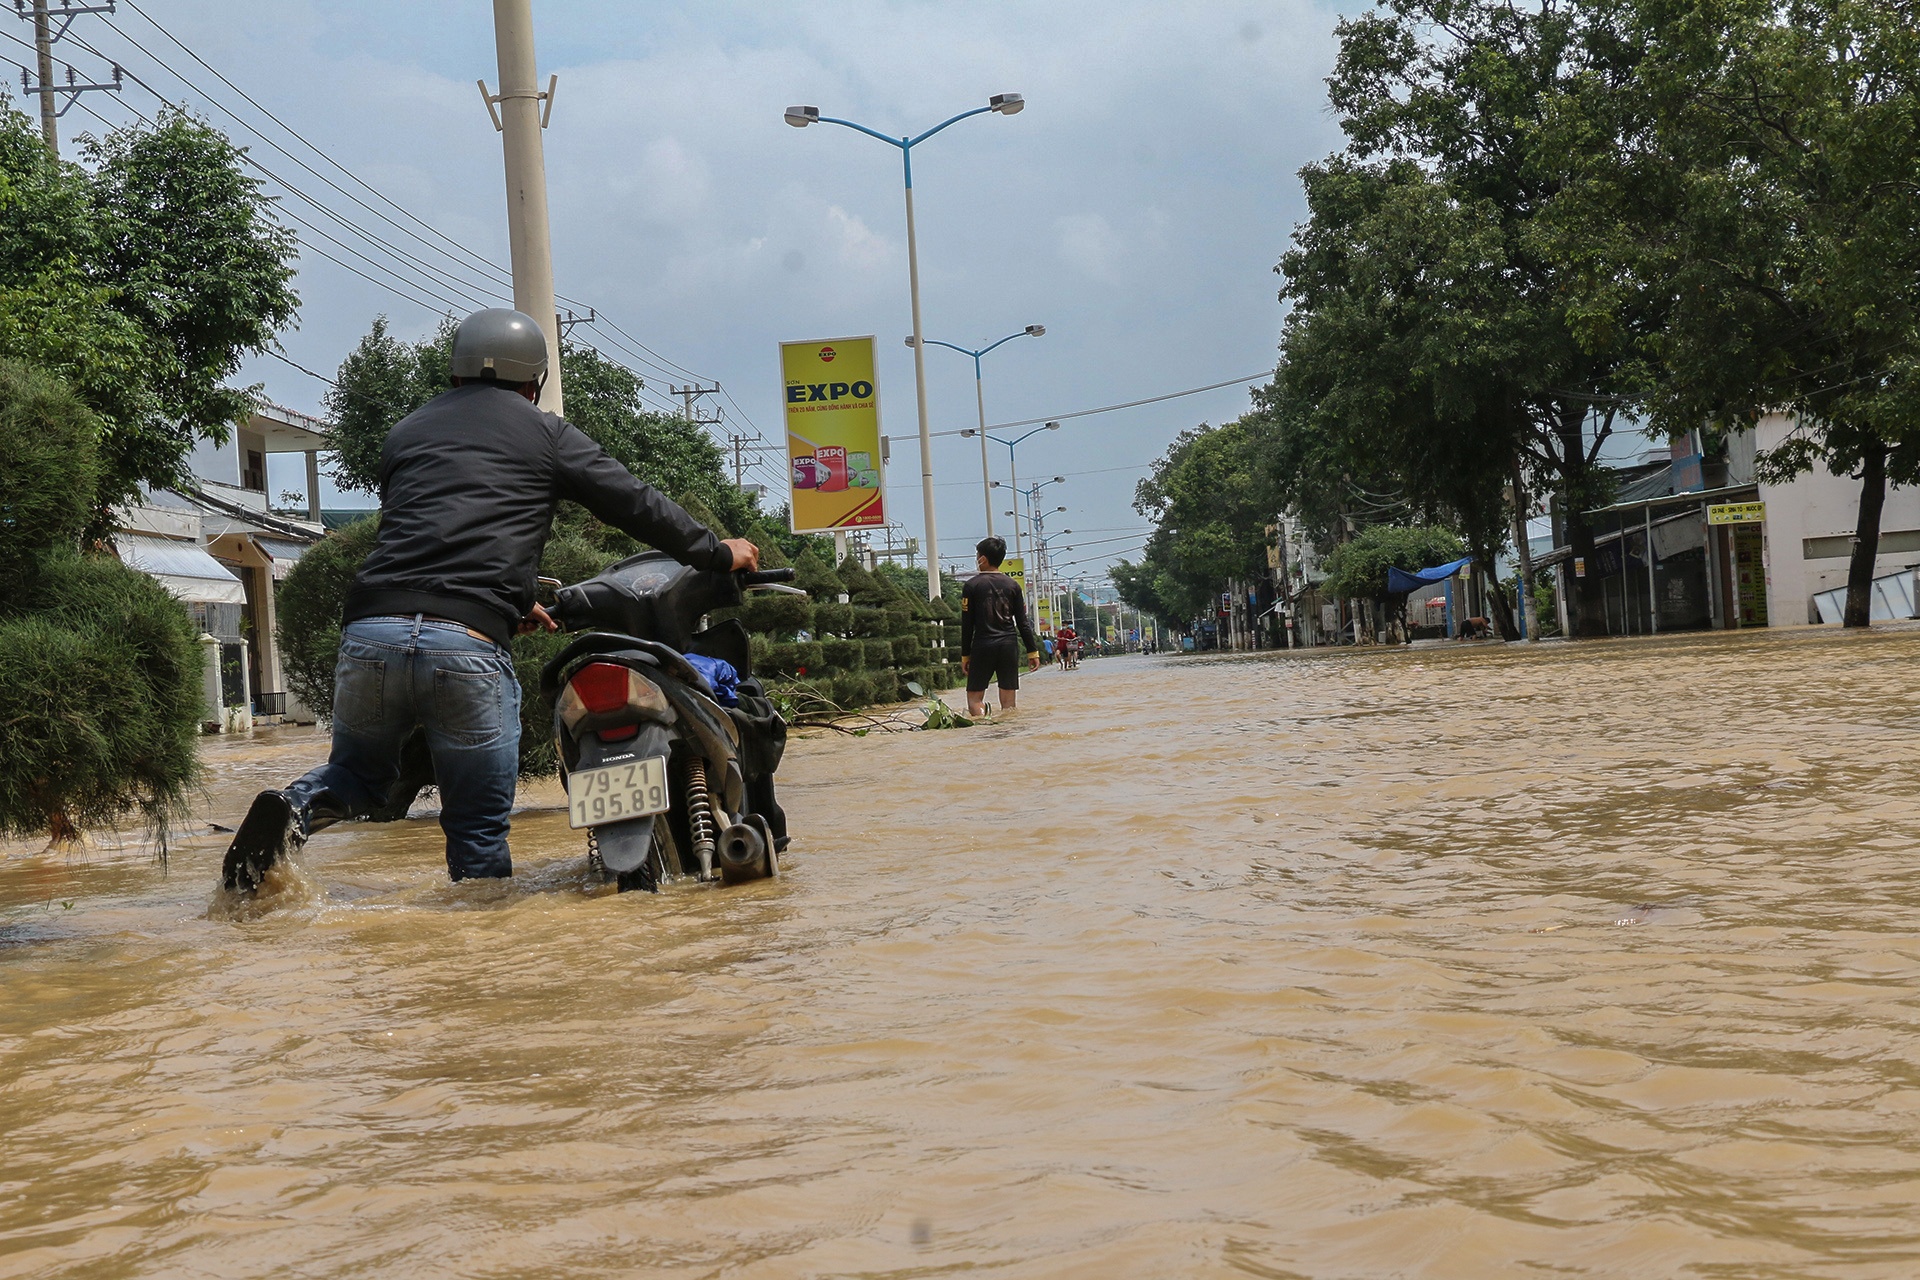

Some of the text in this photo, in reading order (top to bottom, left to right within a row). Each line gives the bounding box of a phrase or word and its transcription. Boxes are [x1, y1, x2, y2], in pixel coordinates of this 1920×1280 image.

[787, 380, 873, 403] EXPO
[840, 402, 852, 410] HÀNH
[817, 448, 844, 458] EXPO
[838, 552, 843, 560] 3
[602, 753, 635, 763] HONDA
[583, 762, 649, 797] 79-Z1
[577, 786, 662, 822] 195.89
